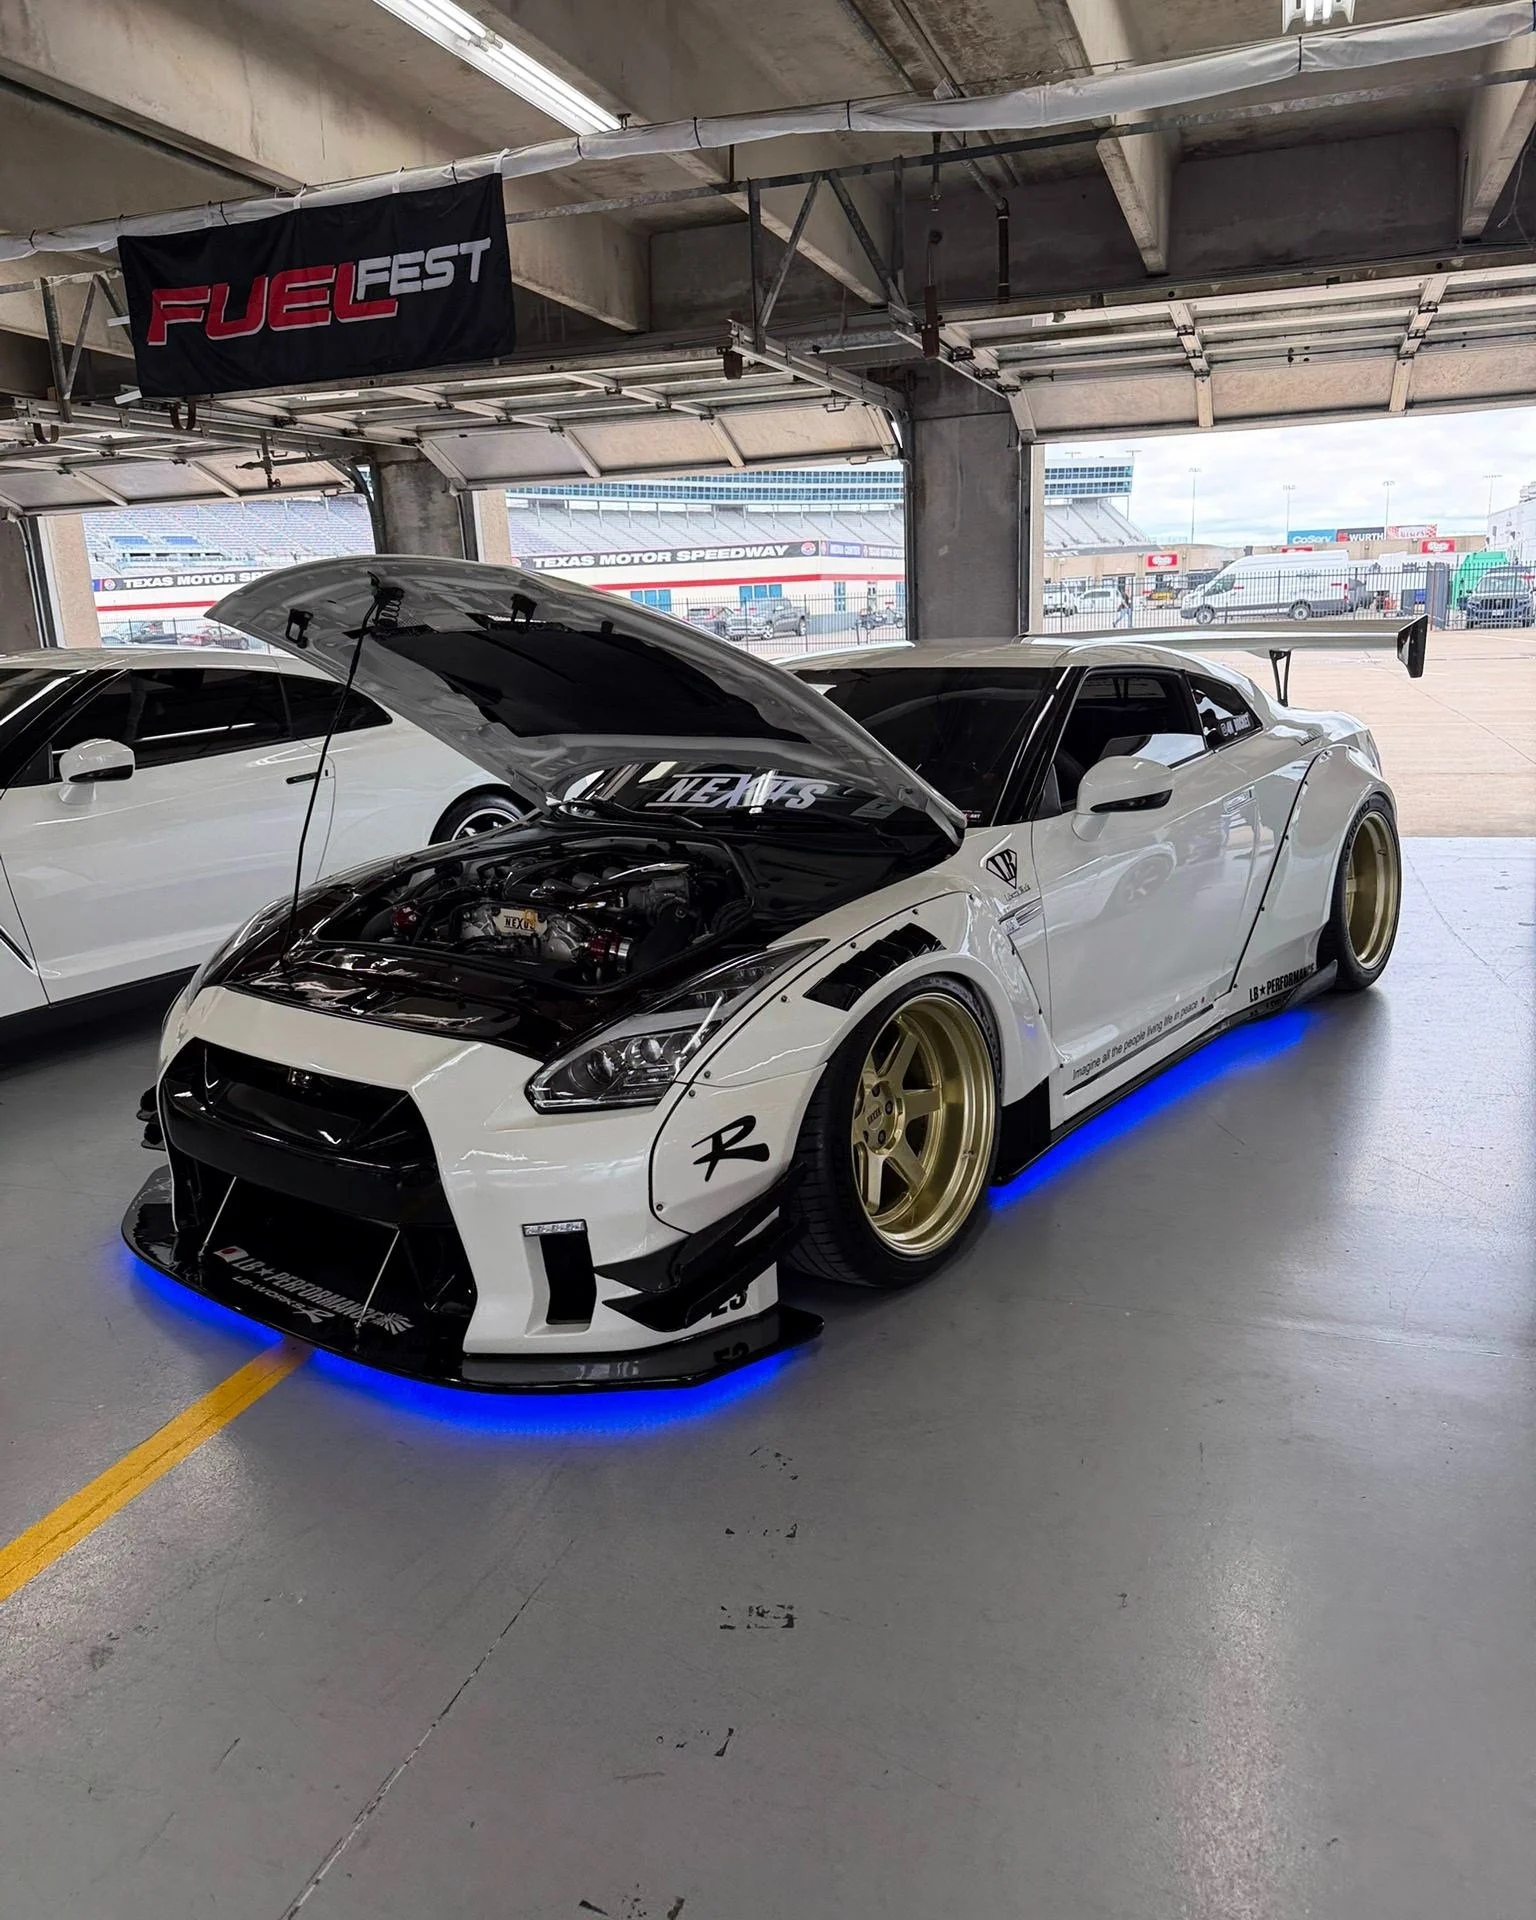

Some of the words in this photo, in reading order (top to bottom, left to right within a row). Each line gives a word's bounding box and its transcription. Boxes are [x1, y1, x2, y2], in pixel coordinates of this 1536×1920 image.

[1292, 535, 1332, 544] CoServ
[533, 555, 594, 568] TEXAS
[599, 551, 672, 566] MOTOR
[676, 545, 790, 562] SPEEDWAY
[124, 578, 174, 589] TEXAS
[177, 573, 237, 586] MOTOR
[1072, 1057, 1101, 1081] Imagine
[1102, 1049, 1111, 1064] all
[1111, 1044, 1122, 1058] the
[1123, 1029, 1146, 1053] people
[1147, 1020, 1163, 1038] living
[1164, 1013, 1173, 1026] life
[1174, 1011, 1180, 1021] in
[1180, 1000, 1198, 1019] peace
